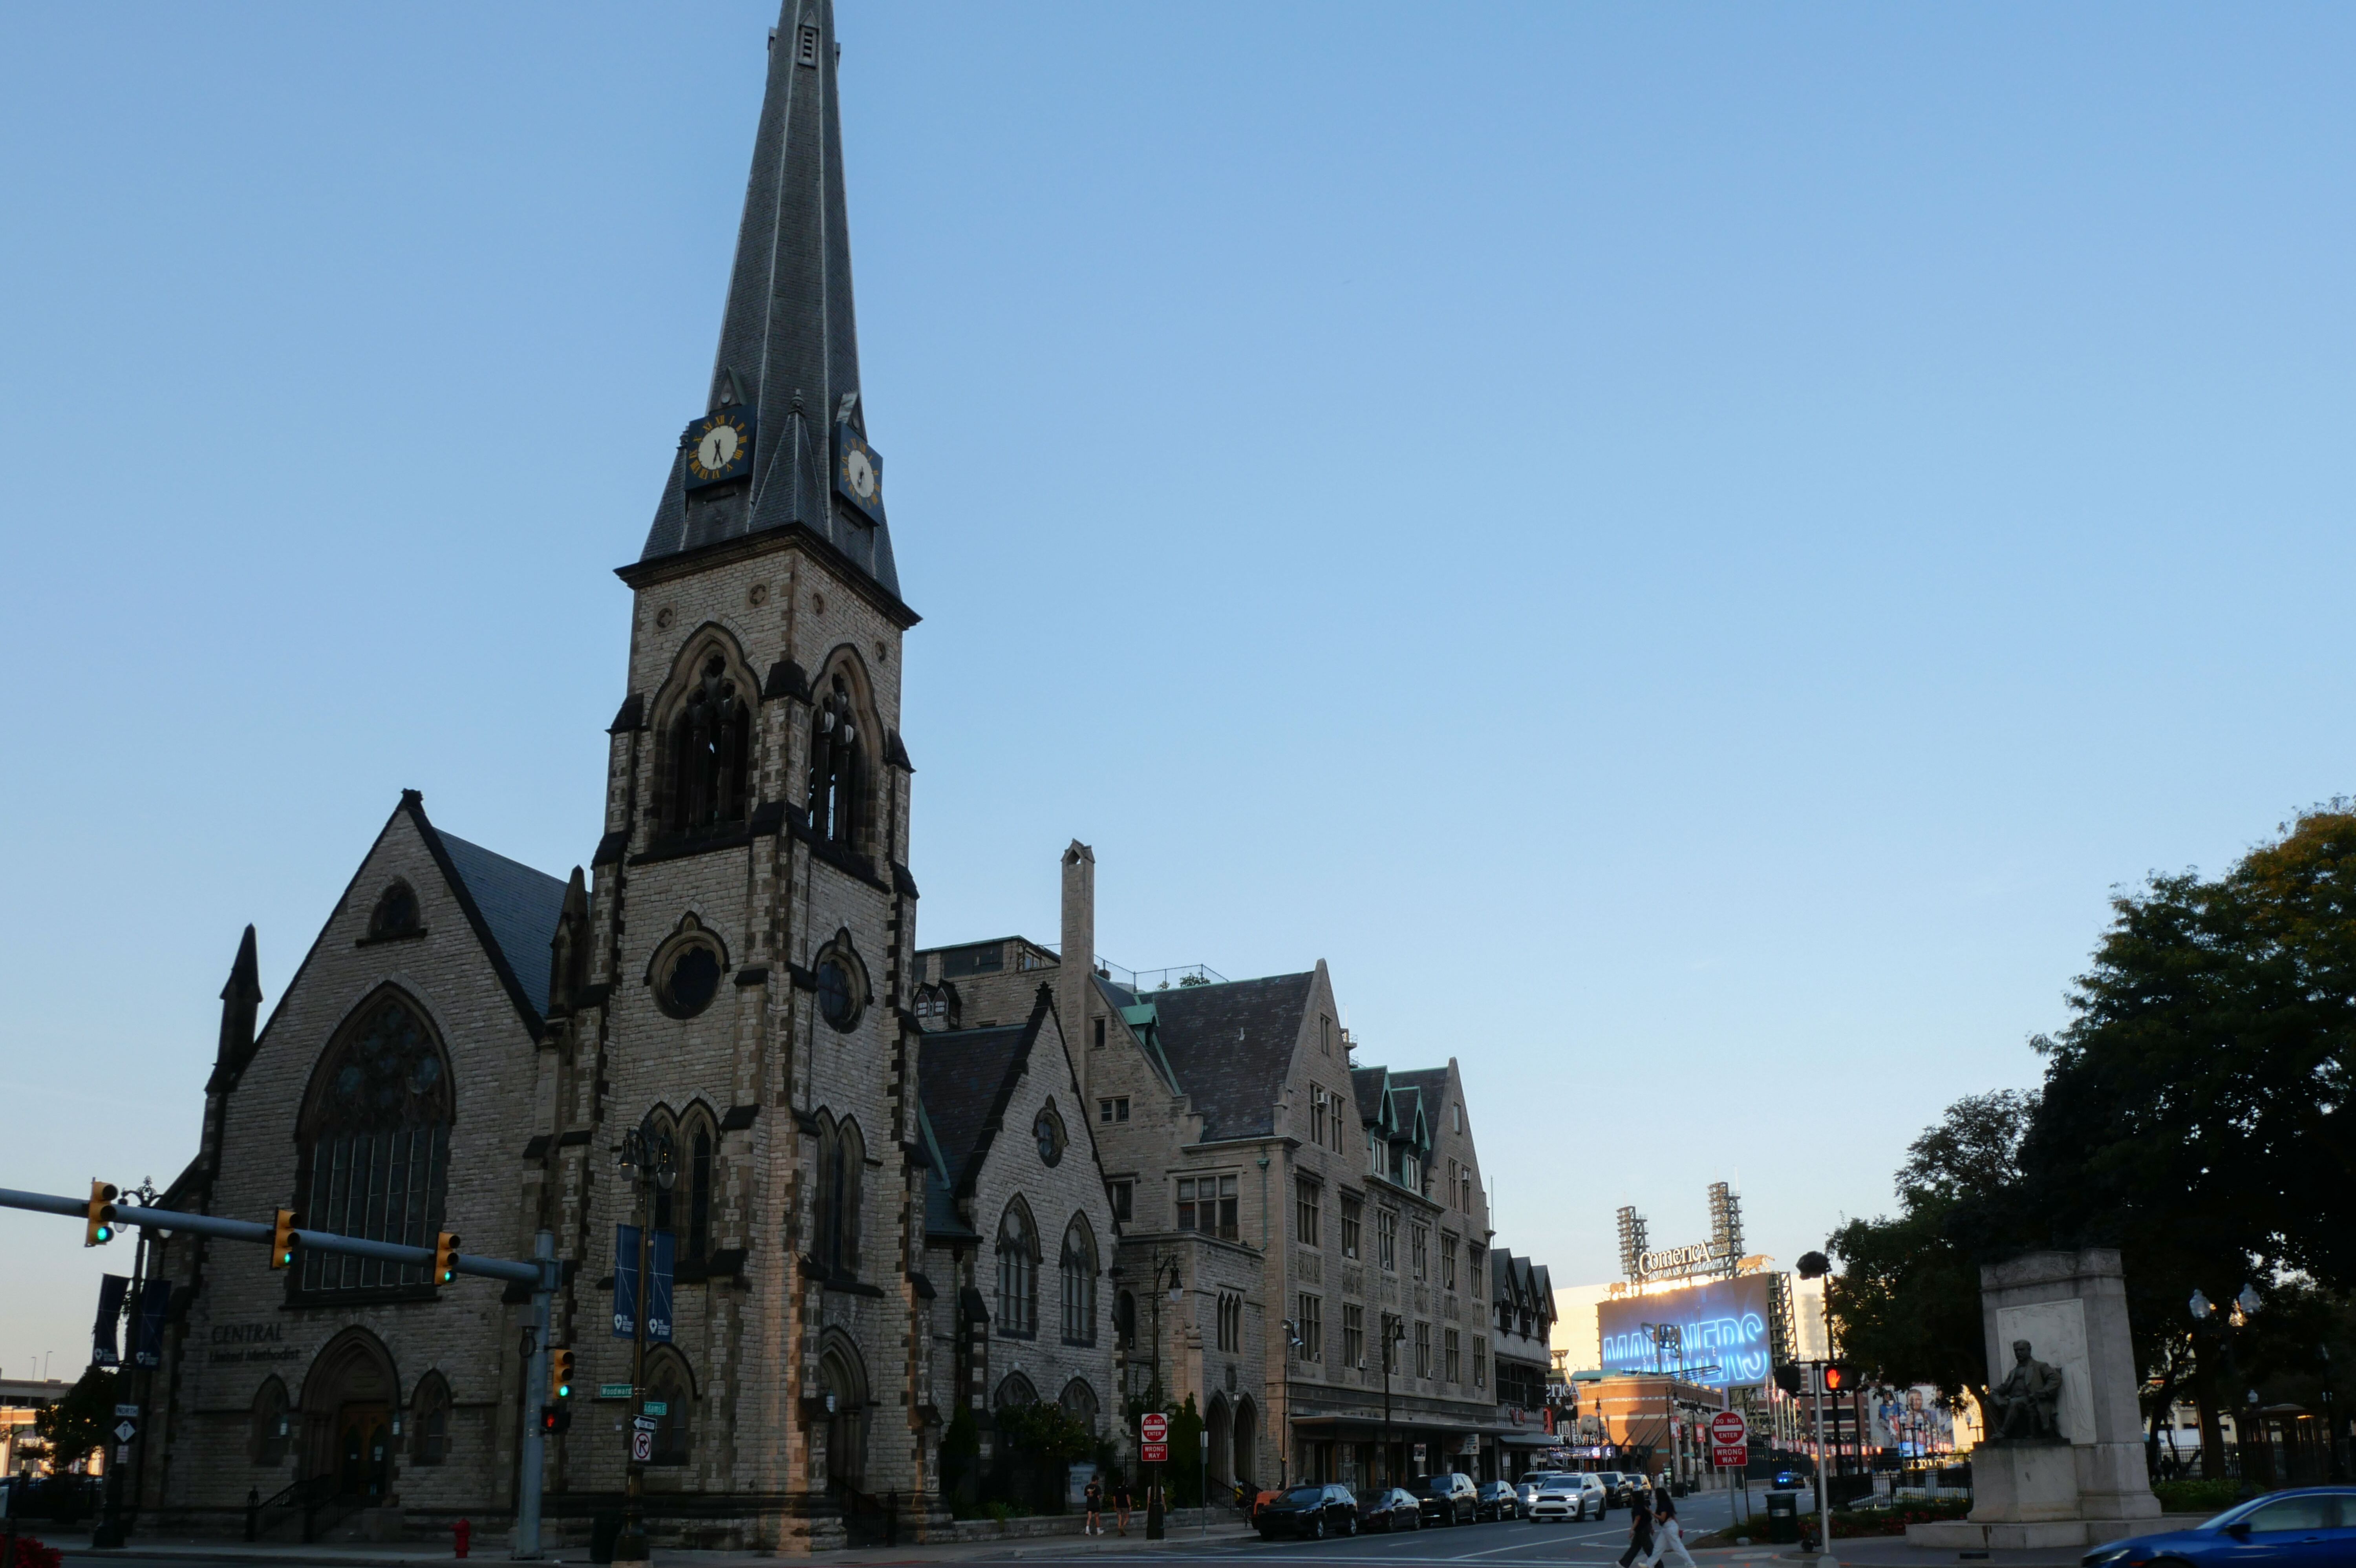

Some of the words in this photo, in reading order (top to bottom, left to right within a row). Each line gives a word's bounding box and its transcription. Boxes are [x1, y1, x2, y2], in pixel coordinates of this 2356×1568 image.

[1659, 1264, 1692, 1279] PARK
[212, 1323, 283, 1343] CENTRAL
[209, 1349, 243, 1362] United
[245, 1347, 300, 1361] Methodist
[602, 1387, 632, 1395] Woodward
[644, 1404, 662, 1413] Adams
[662, 1405, 666, 1413] E
[1573, 1434, 1600, 1445] ENTRY
